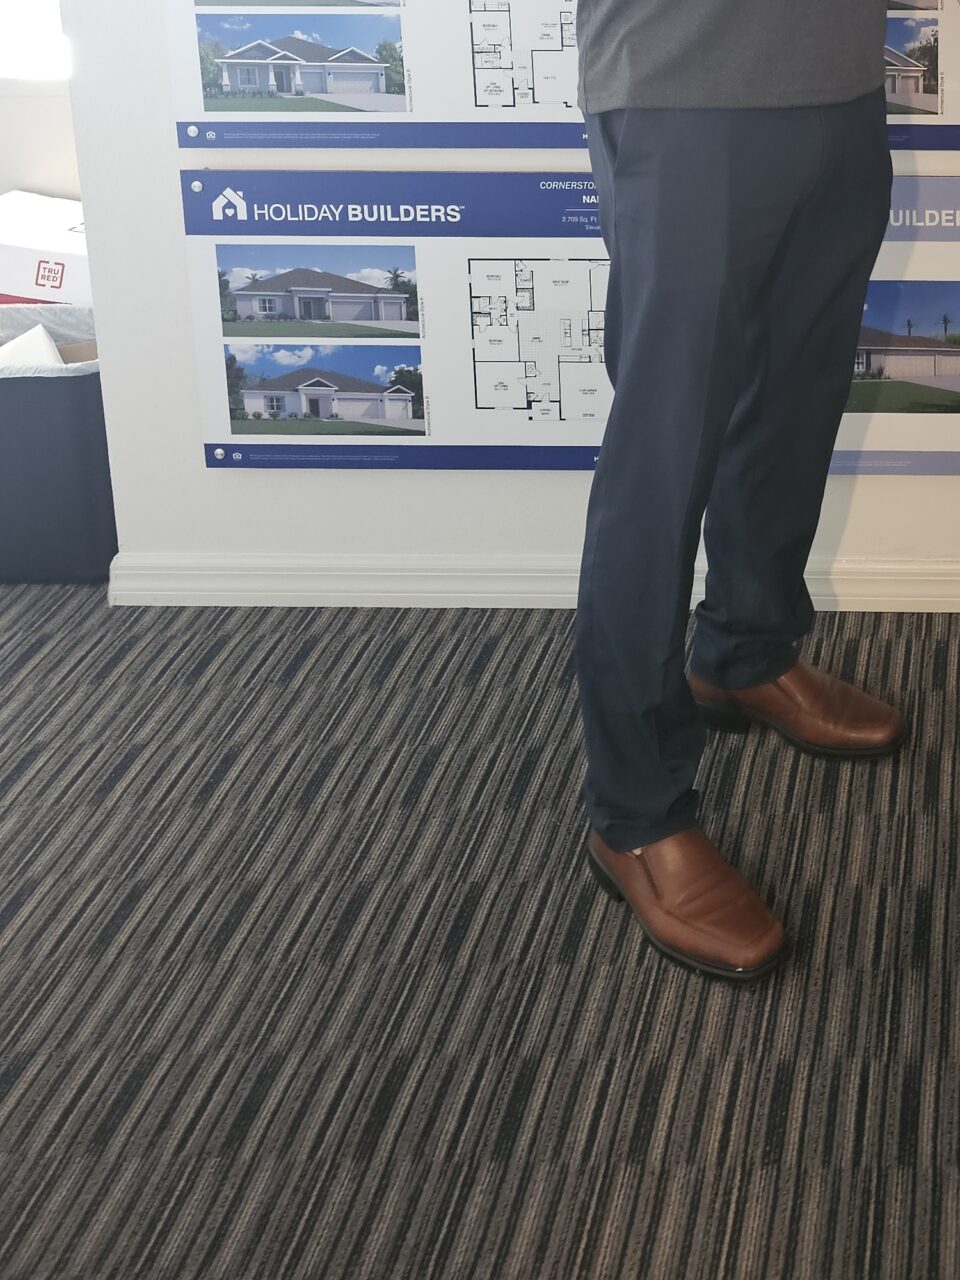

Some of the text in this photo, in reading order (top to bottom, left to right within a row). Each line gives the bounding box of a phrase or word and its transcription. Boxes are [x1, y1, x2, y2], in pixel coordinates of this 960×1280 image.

[540, 182, 597, 191] CORNERSTO
[254, 204, 461, 223] HOLIDAY BUILDERS
[42, 267, 60, 275] TRU
[41, 274, 58, 282] RED
